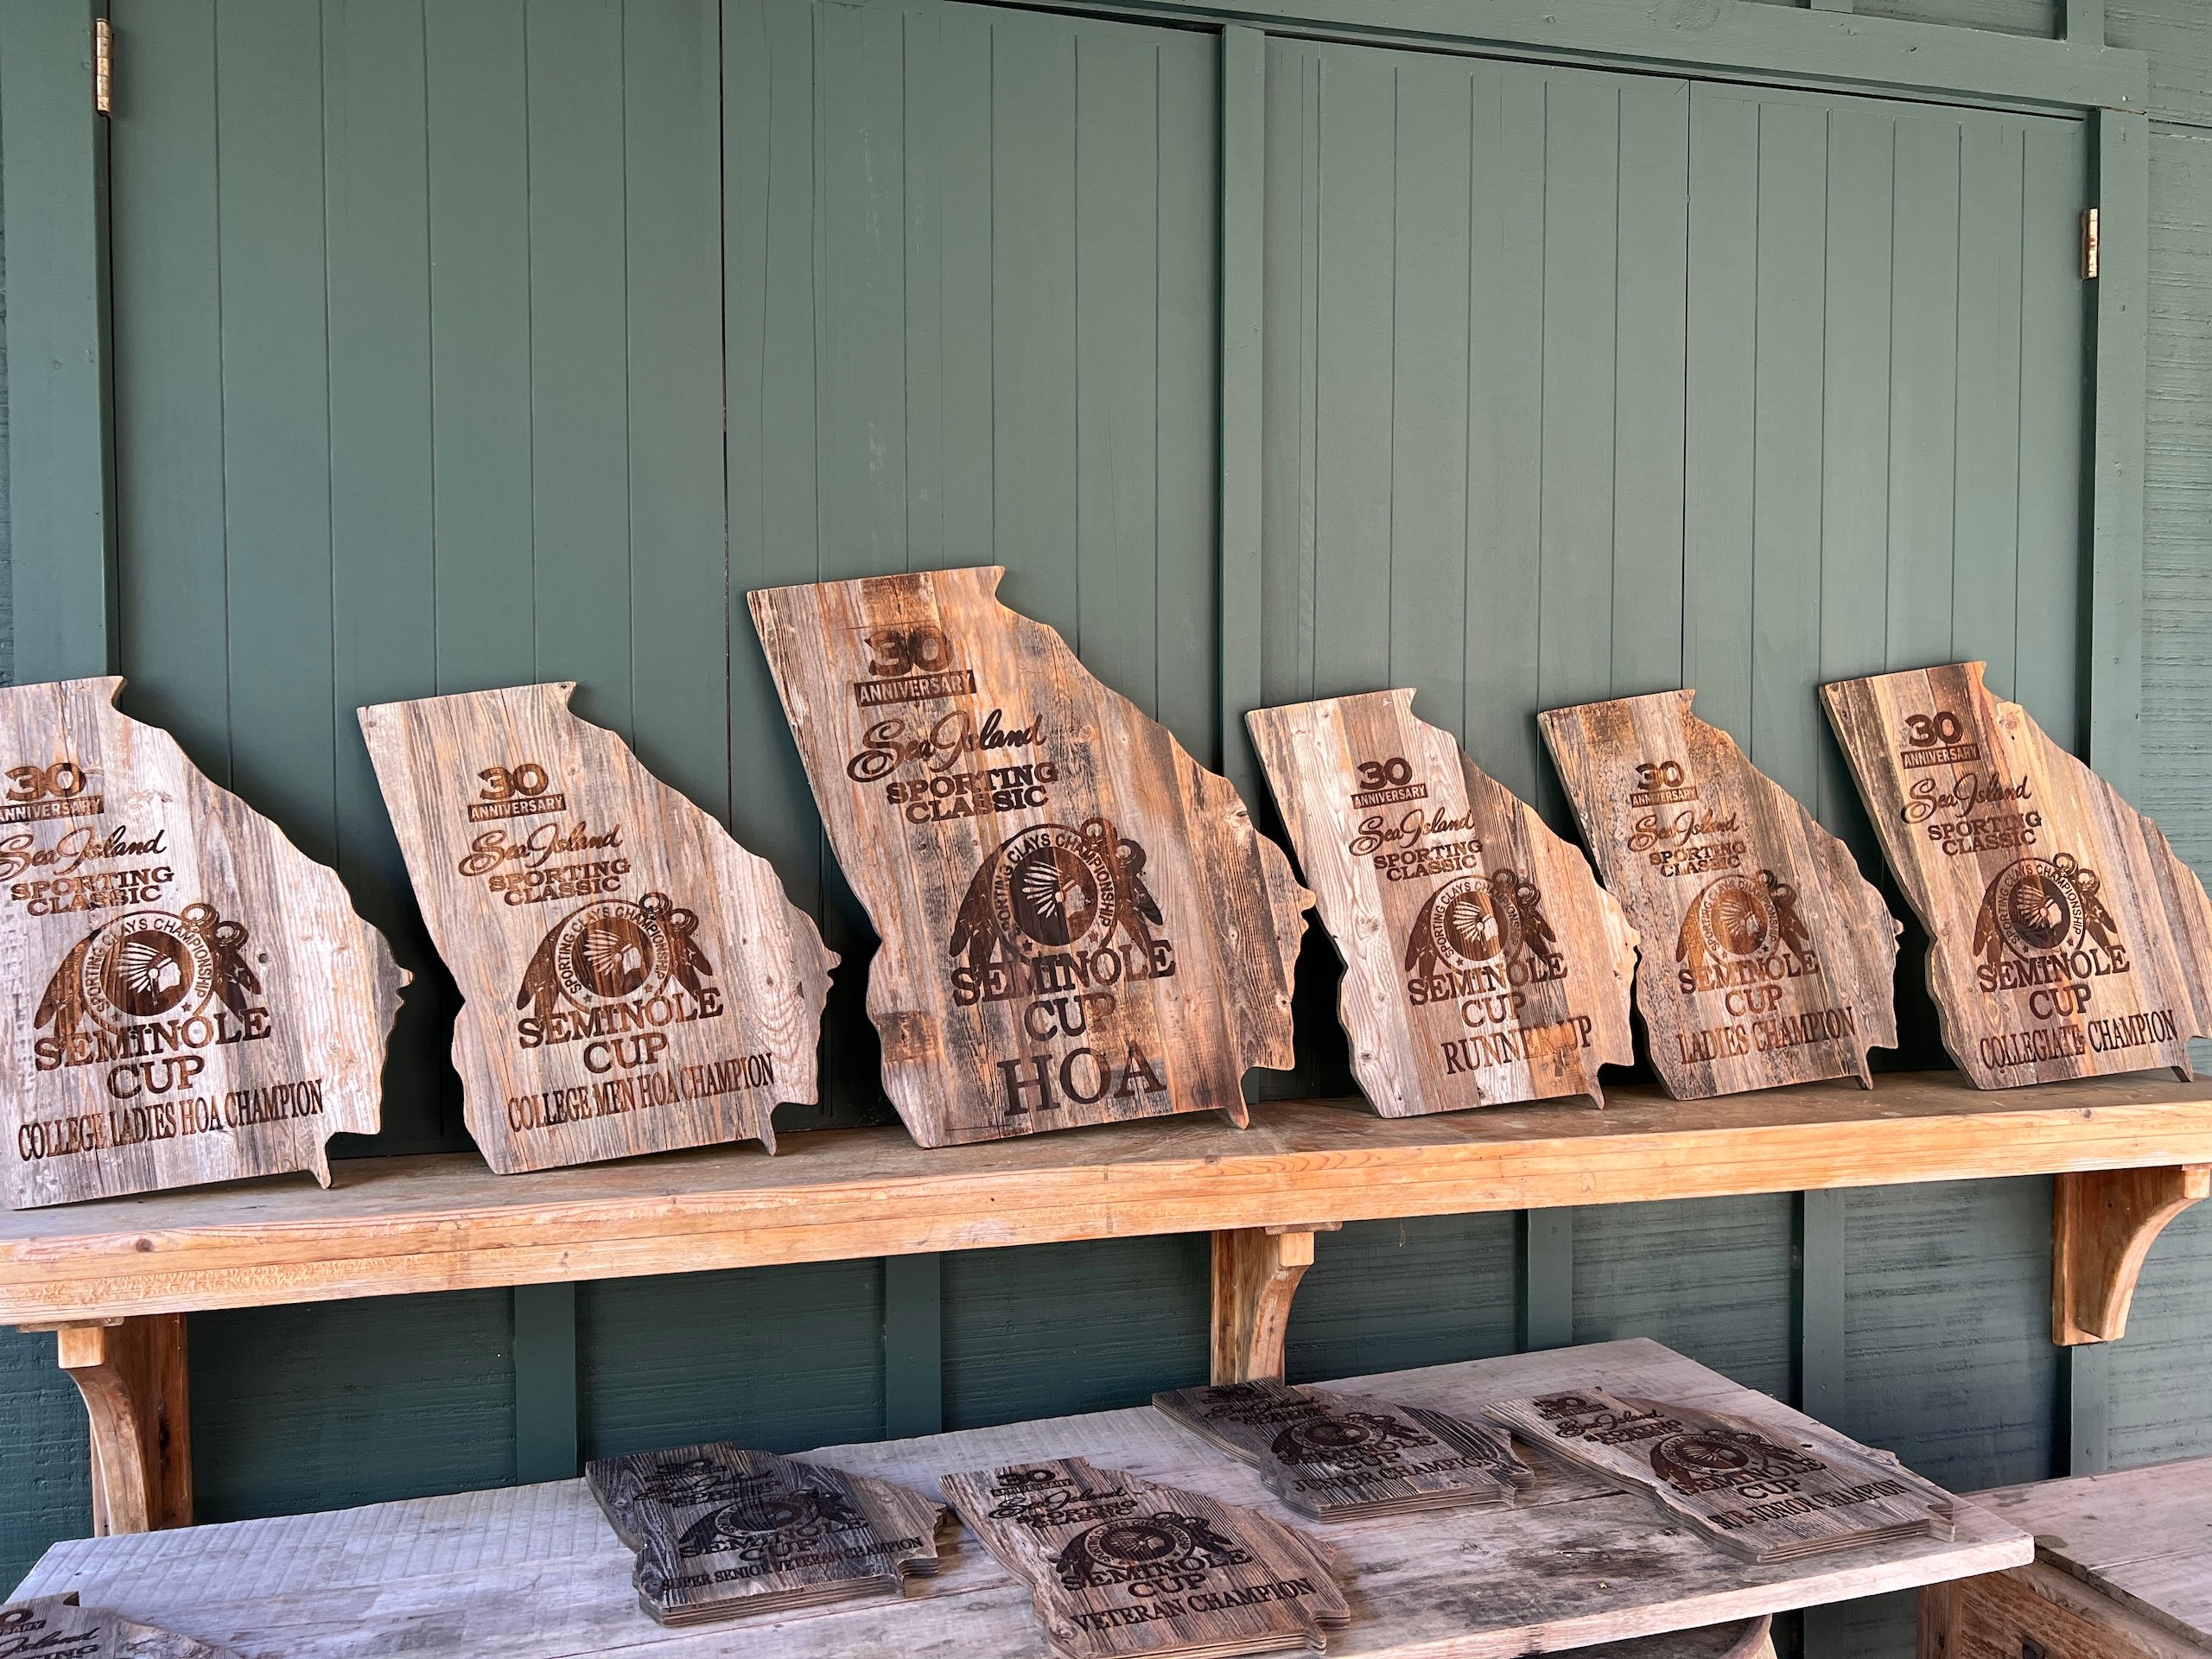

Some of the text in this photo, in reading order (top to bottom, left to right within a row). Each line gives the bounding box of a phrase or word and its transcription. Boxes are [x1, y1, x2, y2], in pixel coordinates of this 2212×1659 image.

[864, 626, 953, 677] 30
[859, 673, 973, 704] ANNIVERSARY
[847, 709, 1046, 783] Sea Island
[1904, 711, 1962, 747] 30
[1357, 758, 1412, 790] 30
[1636, 761, 1684, 790] 30
[1904, 747, 1978, 768] ANNIVERSARY
[5, 763, 86, 801] 30
[478, 763, 549, 800] 30
[887, 761, 1058, 804] SPORTING
[1354, 785, 1425, 807] ANNIVERSARY
[1901, 772, 2031, 823] Sea Island
[471, 797, 563, 819] ANNIVERSARY
[906, 785, 1048, 823] CLASSIC
[1349, 807, 1474, 856] Sea Island
[1627, 808, 1739, 852] Sea Island
[1928, 811, 2042, 841] SPORTING
[1942, 830, 2036, 855] CLASSIC
[54, 825, 167, 875] Island
[458, 821, 623, 877] Sea Island
[1374, 839, 1483, 869] SPORTING
[1387, 855, 1477, 881] CLASSIC
[1649, 841, 1746, 866] SPORTING
[1660, 855, 1740, 877] CLASSIC
[11, 867, 174, 900] SPORTING
[489, 858, 631, 893] SPORTING
[505, 876, 621, 906] CLASSIC
[1007, 833, 1052, 864] CLAYS
[1055, 833, 1115, 927] CHAMPIONSHIP
[1440, 881, 1471, 904] CLAYS
[27, 885, 162, 916] CLASSIC
[1998, 888, 2020, 944] SPORTING
[2036, 864, 2082, 935] CHAMPIONSHIP
[1433, 906, 1454, 958] SPORTING
[1701, 901, 1720, 950] SPORTING
[86, 945, 111, 1013] SPORTING
[153, 918, 213, 999] CHAMPIONSHIP
[558, 906, 669, 995] SPORTING CLAYS CHAMPIONSHIP
[1976, 944, 2130, 993] SEMINOLE
[950, 939, 1176, 1007] SEMINOLE
[1408, 952, 1567, 1006] SEMINOLE
[1678, 950, 1819, 994] SEMINOLE
[518, 988, 724, 1049] SEMINOLE
[1025, 992, 1116, 1041] CUP
[1461, 992, 1526, 1027] CUP
[1725, 984, 1783, 1016] CUP
[2030, 984, 2092, 1020] CUP
[35, 1007, 271, 1071] SEMINOLE
[583, 1032, 668, 1073] CUP
[1441, 1015, 1592, 1074] RUNNER UP
[1677, 1007, 1856, 1065] LADIES CHAMPION
[1980, 1009, 2178, 1071] COLLEGIATE CHAMPION
[107, 1055, 206, 1099] CUP
[508, 1053, 775, 1132] COLLEGE MEN HOA CHAMPION
[997, 1039, 1166, 1116] HOA
[18, 1079, 324, 1161] COLLEGE LADIES HOA CHAMPION
[995, 1470, 1055, 1486] 30
[1294, 1472, 1379, 1492] JUNIOR
[1339, 1452, 1402, 1471] CUP
[1738, 1478, 1801, 1499] CUP
[1812, 1479, 1910, 1508] CHAMPION
[663, 1536, 924, 1591] SUPER SENIOR VETERAN CHAMPION
[1061, 1549, 1252, 1591] SEMINOLE
[1070, 1578, 1318, 1632] VETERAN CHAMPION
[1128, 1573, 1206, 1598] CUP
